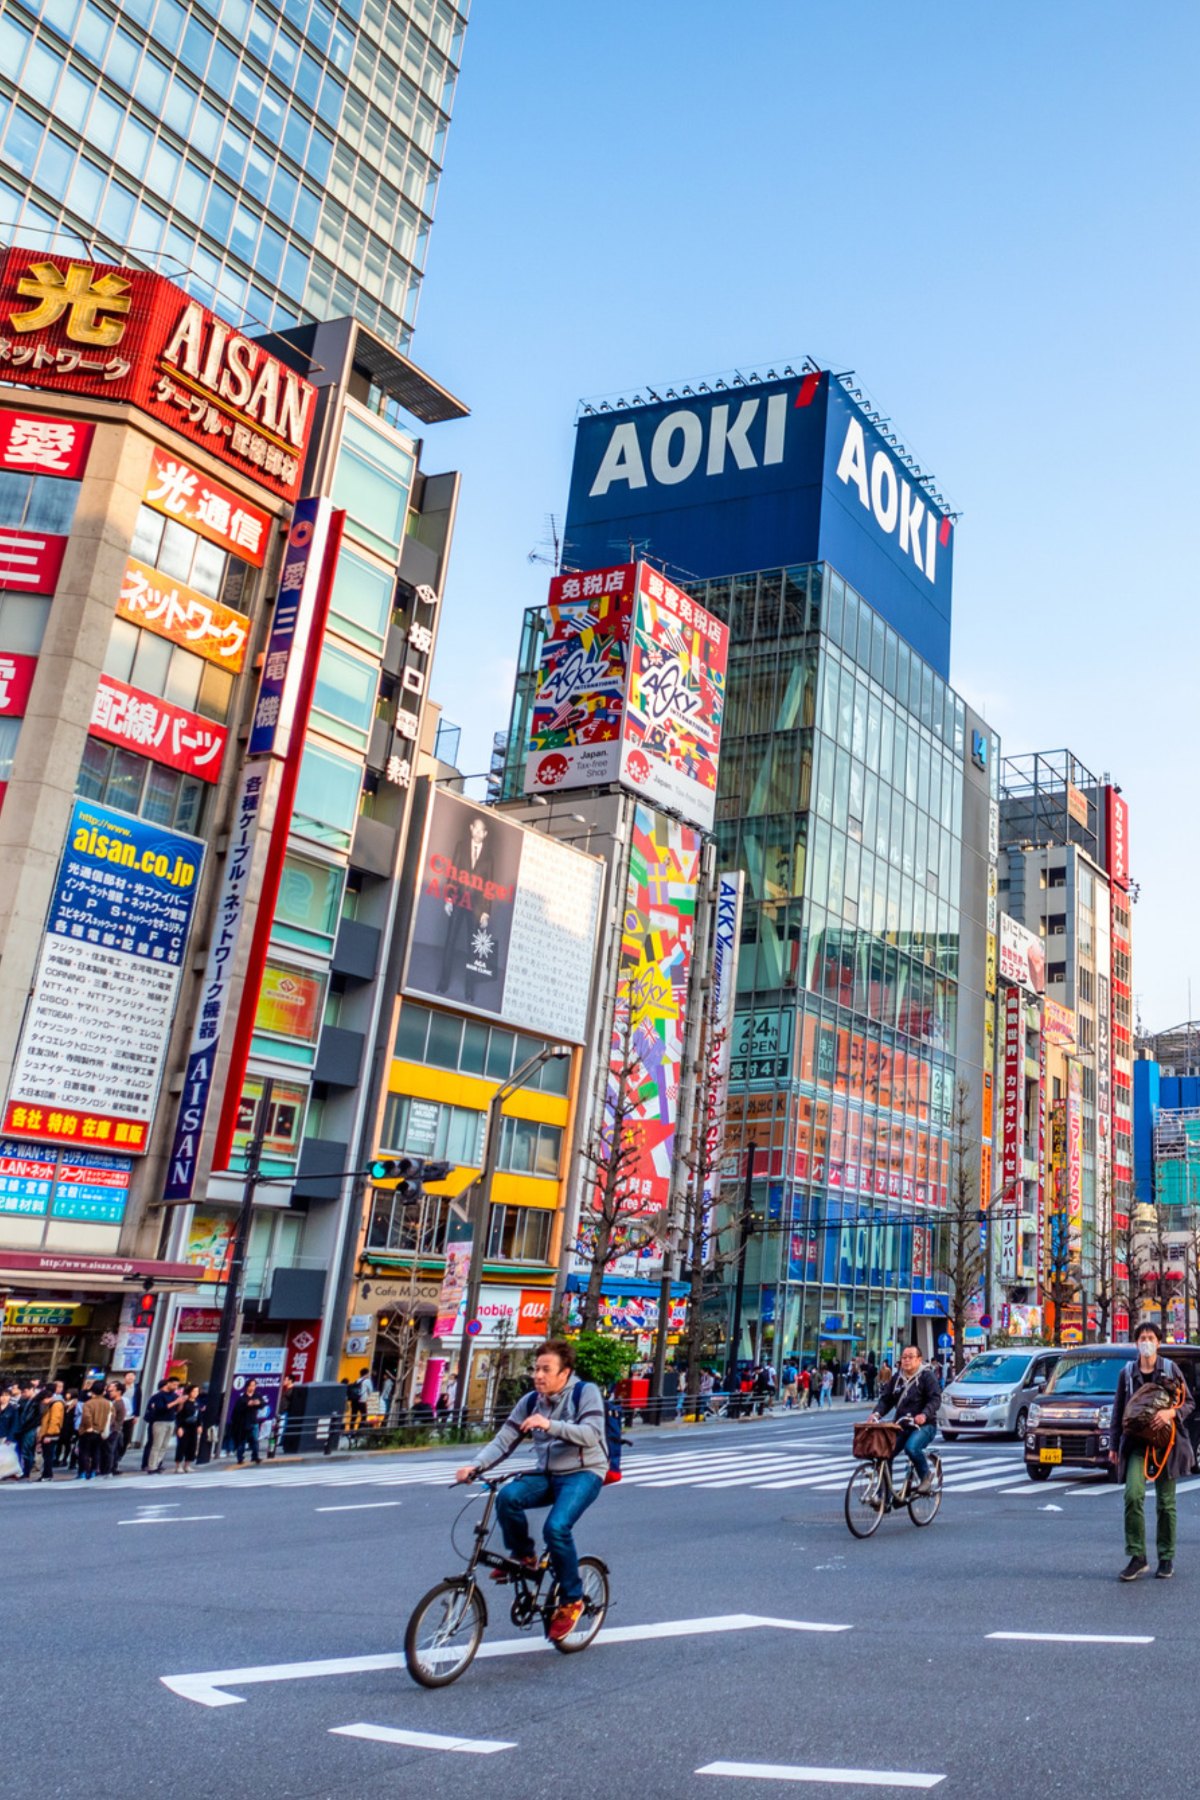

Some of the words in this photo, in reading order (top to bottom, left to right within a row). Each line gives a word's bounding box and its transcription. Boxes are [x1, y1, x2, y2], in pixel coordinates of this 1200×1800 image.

[9, 261, 132, 347] 光
[162, 302, 316, 449] AISAN
[4, 417, 76, 472] 愛
[588, 392, 788, 498] AOKI
[146, 460, 264, 554] 光通信
[836, 415, 938, 586] AOKI
[119, 569, 247, 657] ネットワーク
[561, 570, 625, 600] 免税店
[648, 574, 722, 646] 愛客免税店
[256, 560, 306, 729] 愛三電機
[386, 622, 434, 790] 坂口電熱
[574, 679, 619, 692] INTERNATIONAL
[643, 668, 697, 715] AKKY
[89, 682, 223, 766] 配線パーツ
[669, 707, 711, 738] INTERNATIONAL
[586, 767, 608, 779] Shop
[70, 821, 196, 890] aisan.co.jp
[1114, 801, 1124, 879] カラオケ
[425, 882, 475, 911] AGA
[430, 853, 514, 902] Change!
[718, 879, 736, 950] AKKY
[1000, 961, 1029, 982] カラオケ
[739, 1040, 777, 1055] OPEN
[12, 1107, 42, 1130] 各社
[47, 1112, 77, 1135] 特約
[82, 1117, 112, 1139] 在庫
[115, 1122, 144, 1144] 直販
[171, 1056, 208, 1185] AISAN
[1005, 1076, 1017, 1134] カラオケ
[840, 1219, 894, 1272] AOKI
